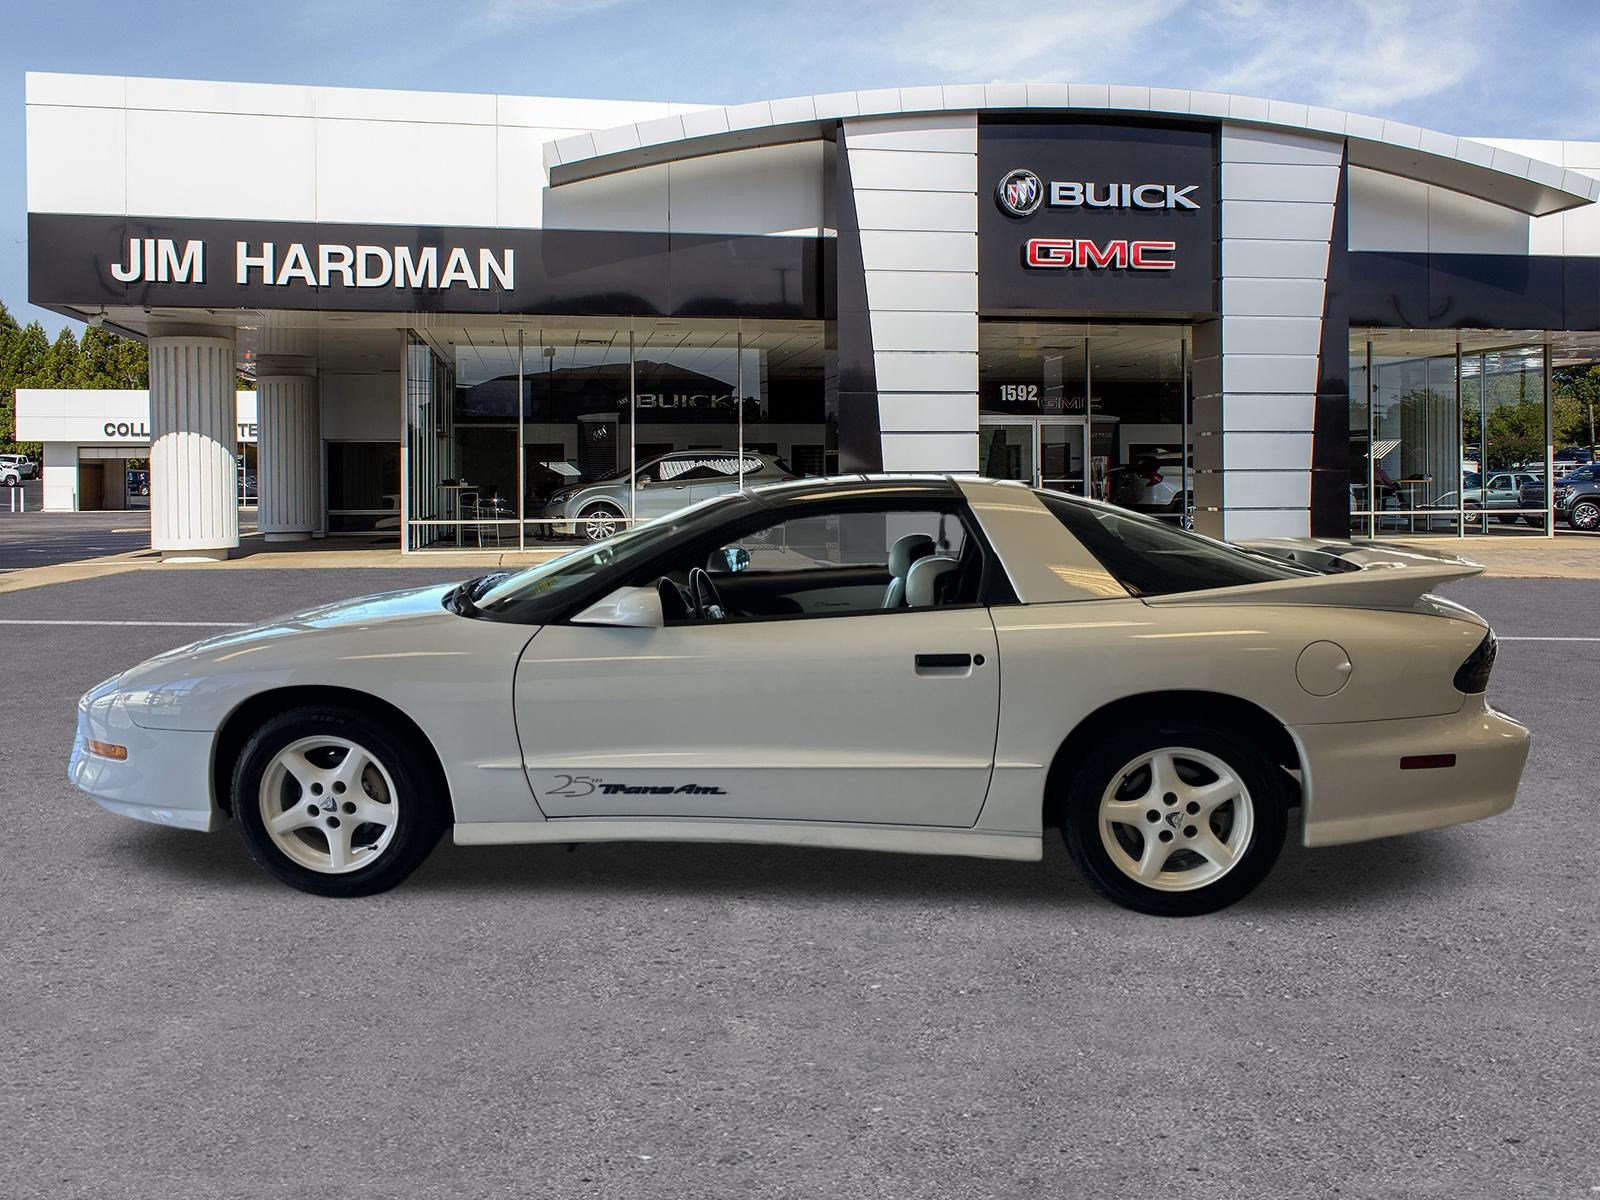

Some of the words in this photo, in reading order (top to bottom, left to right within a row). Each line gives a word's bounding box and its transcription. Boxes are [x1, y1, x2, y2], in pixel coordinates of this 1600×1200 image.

[1050, 181, 1201, 209] BUICK
[1026, 238, 1176, 270] GMC
[110, 237, 204, 284] JIM
[235, 240, 515, 291] HARDMAN
[1000, 384, 1038, 401] 1592
[635, 393, 732, 409] BUICK
[1037, 396, 1102, 409] GMC
[103, 422, 151, 437] COLL
[237, 423, 258, 437] TE
[599, 783, 676, 795] Trans
[672, 783, 728, 795] Am
